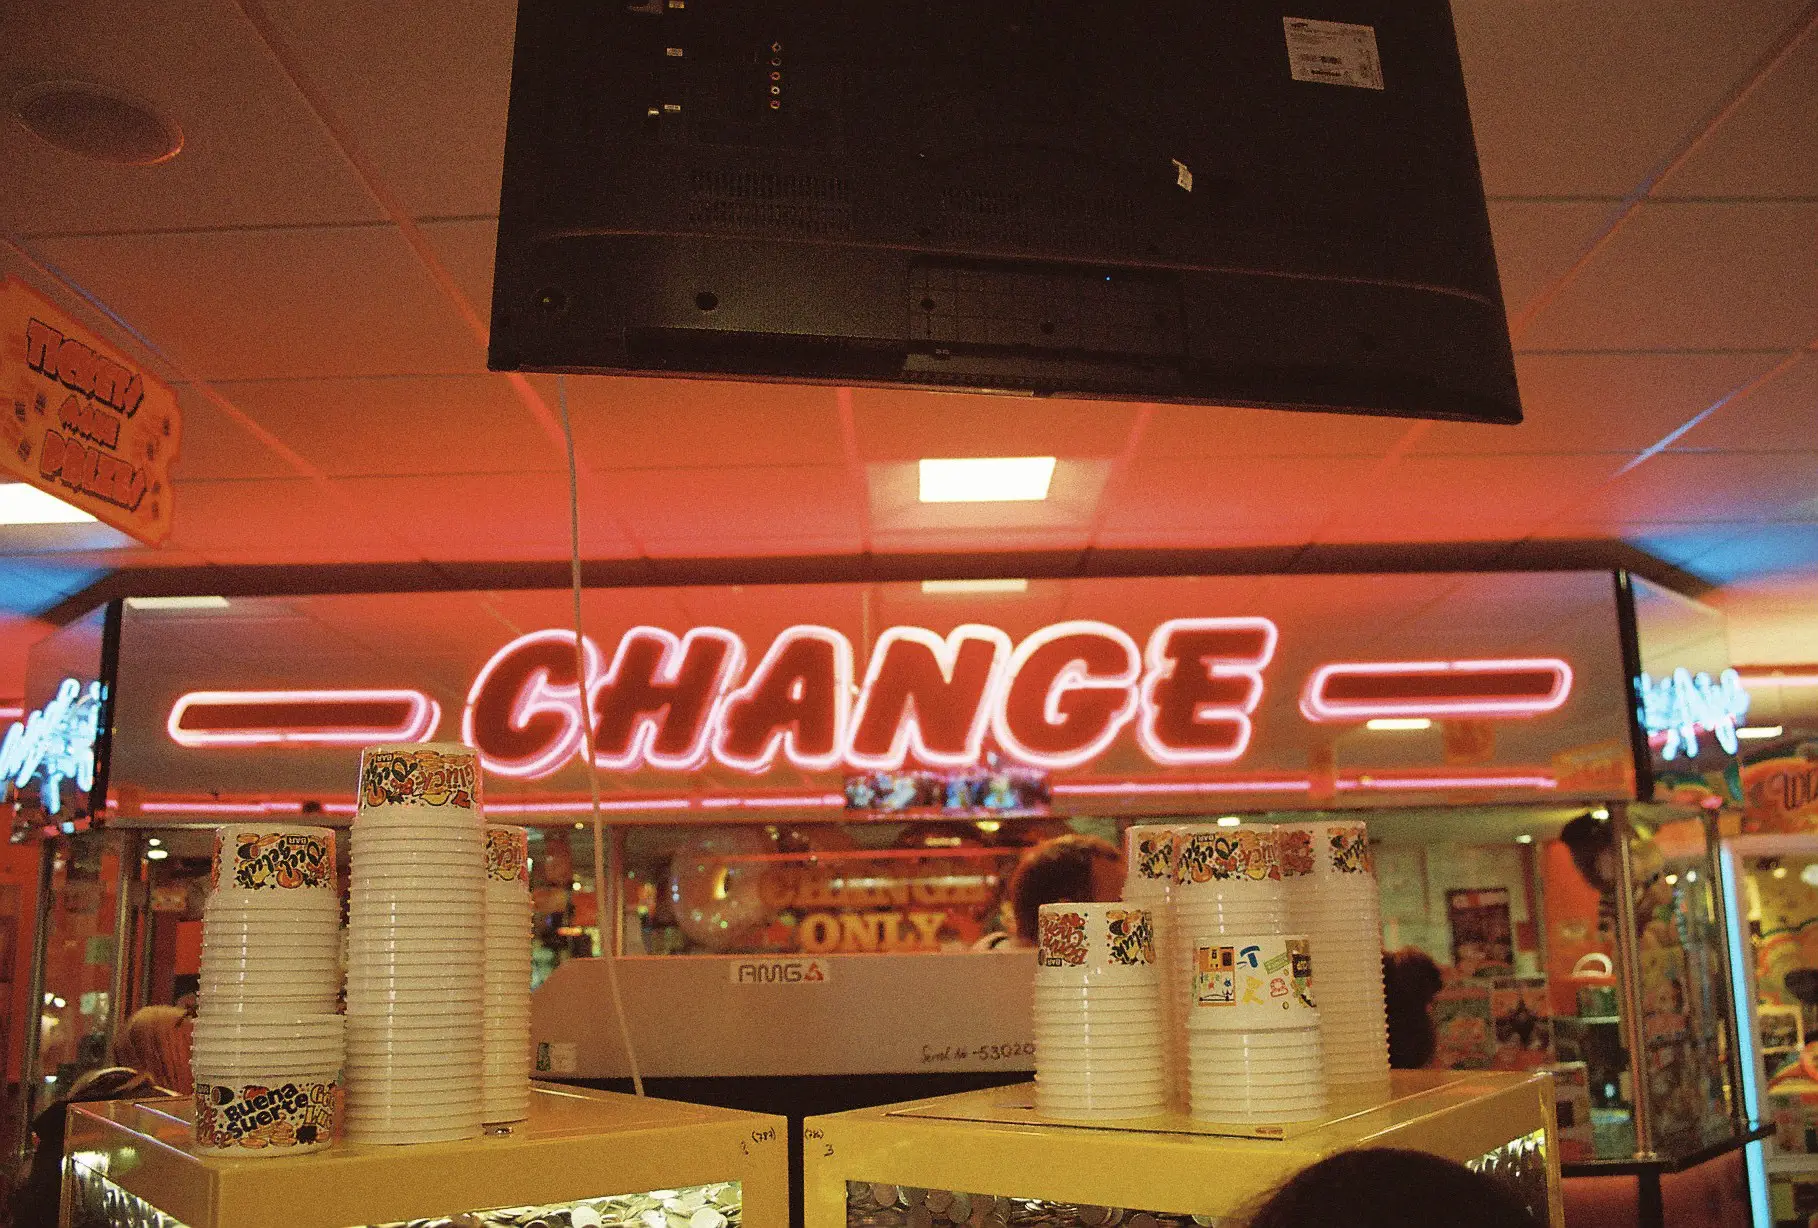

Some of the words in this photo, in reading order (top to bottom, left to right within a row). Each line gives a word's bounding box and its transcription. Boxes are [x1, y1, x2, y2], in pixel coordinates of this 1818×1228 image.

[463, 617, 1278, 777] CHANGE
[800, 912, 946, 953] ONLY
[224, 1083, 299, 1122] Buena
